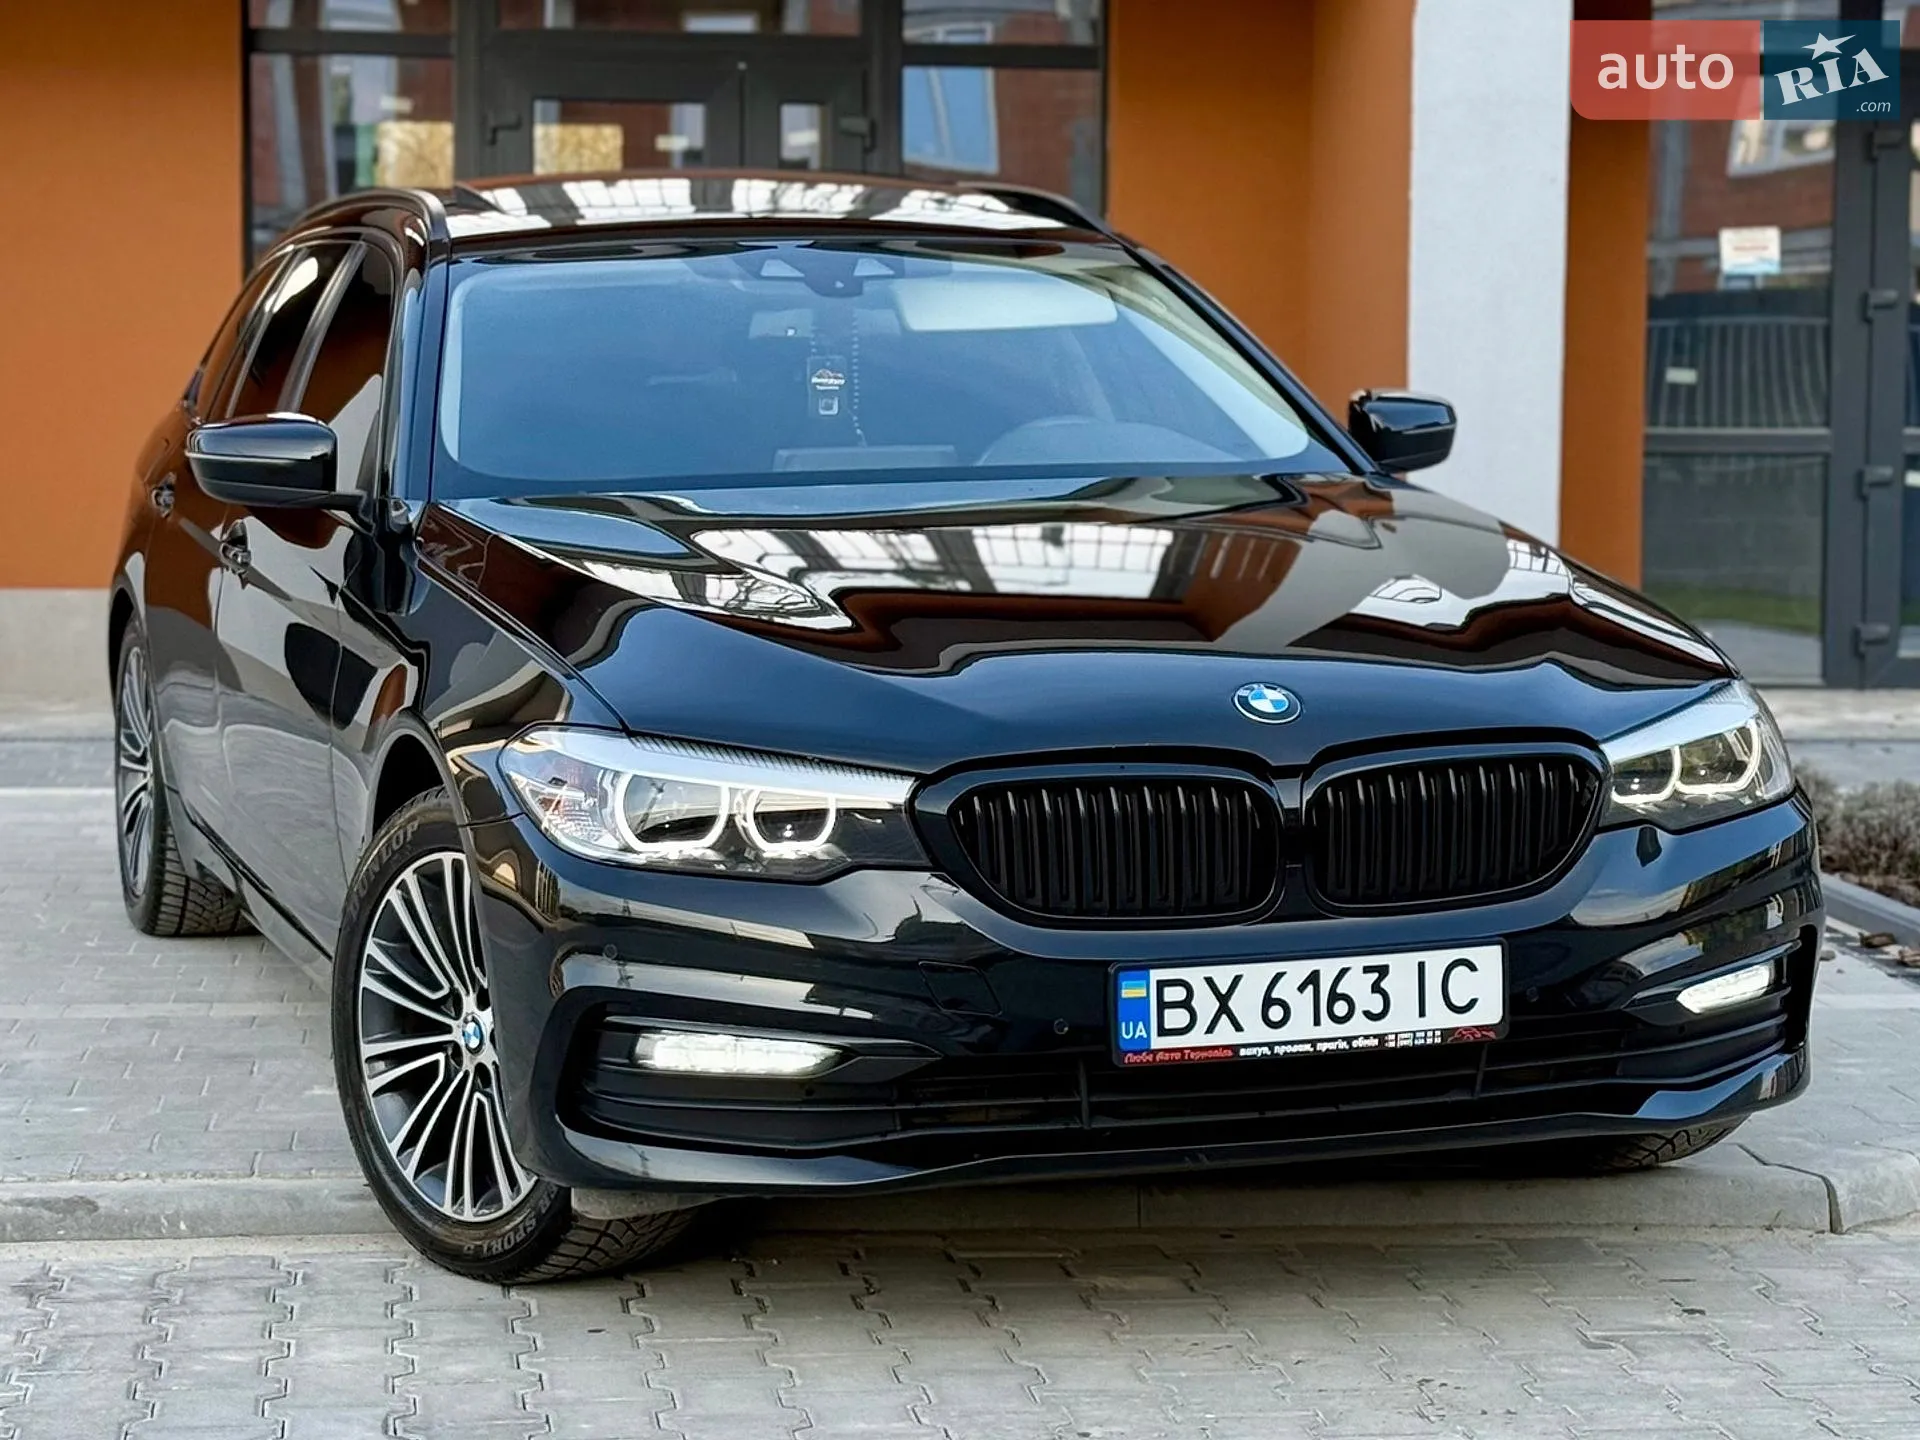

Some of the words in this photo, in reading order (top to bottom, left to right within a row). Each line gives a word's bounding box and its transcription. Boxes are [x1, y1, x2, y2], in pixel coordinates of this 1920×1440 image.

[1155, 973, 1245, 1038] BX
[1260, 963, 1392, 1030] 6163
[1417, 957, 1480, 1019] IC
[1121, 1021, 1148, 1040] UA
